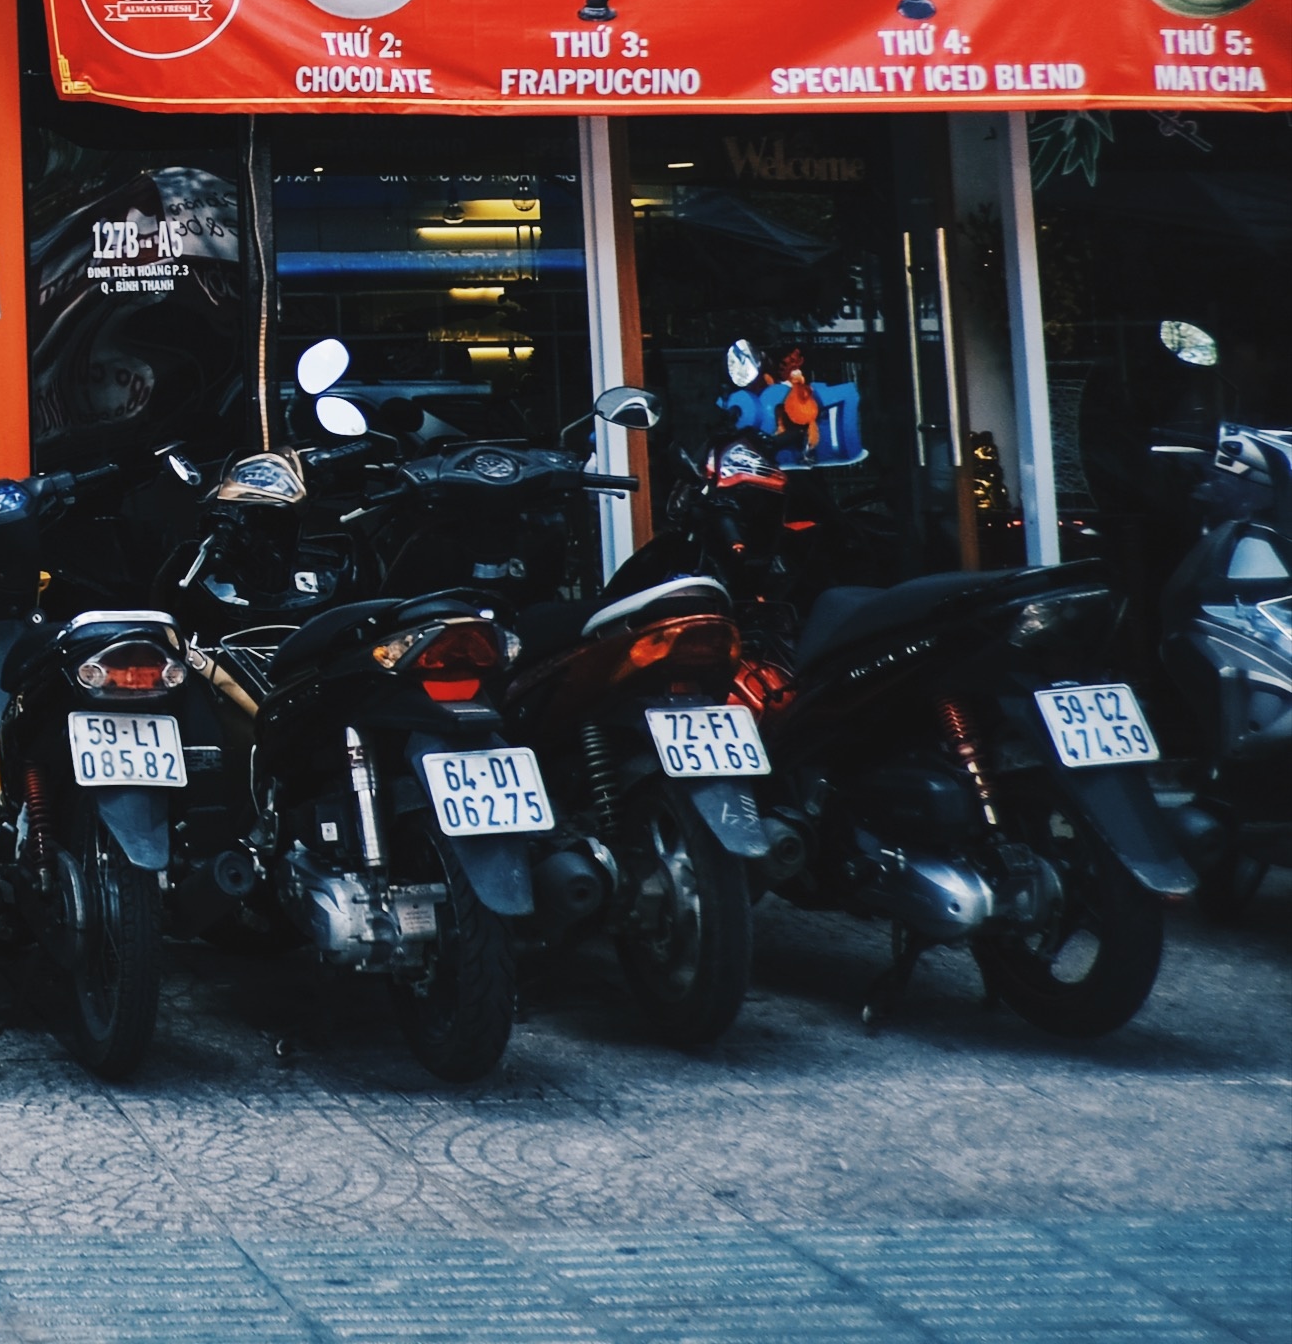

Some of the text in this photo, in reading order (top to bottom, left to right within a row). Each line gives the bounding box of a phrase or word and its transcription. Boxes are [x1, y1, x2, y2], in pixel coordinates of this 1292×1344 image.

[125, 4, 192, 13] ALWAYS FRESH
[321, 30, 403, 59] THỨ 2:
[551, 25, 649, 59] THỨ 3:
[878, 23, 972, 57] THỨ 4:
[1160, 24, 1253, 56] THỨ 5:
[295, 66, 435, 95] CHOCOLATE
[501, 66, 701, 96] FRAPPUCCINO
[770, 63, 1086, 94] SPECIALTY ICED BLEND
[1154, 65, 1266, 93] MATCHA
[724, 134, 865, 182] Welcome
[86, 266, 111, 279] ĐINH
[1053, 690, 1129, 726] 59-C2
[86, 717, 161, 749] 59-L1
[664, 711, 739, 741] 72-F1
[665, 741, 761, 772] 051.69
[1061, 723, 1151, 761] 474.59
[80, 749, 179, 781] 085.82
[442, 790, 544, 829] 062.75
